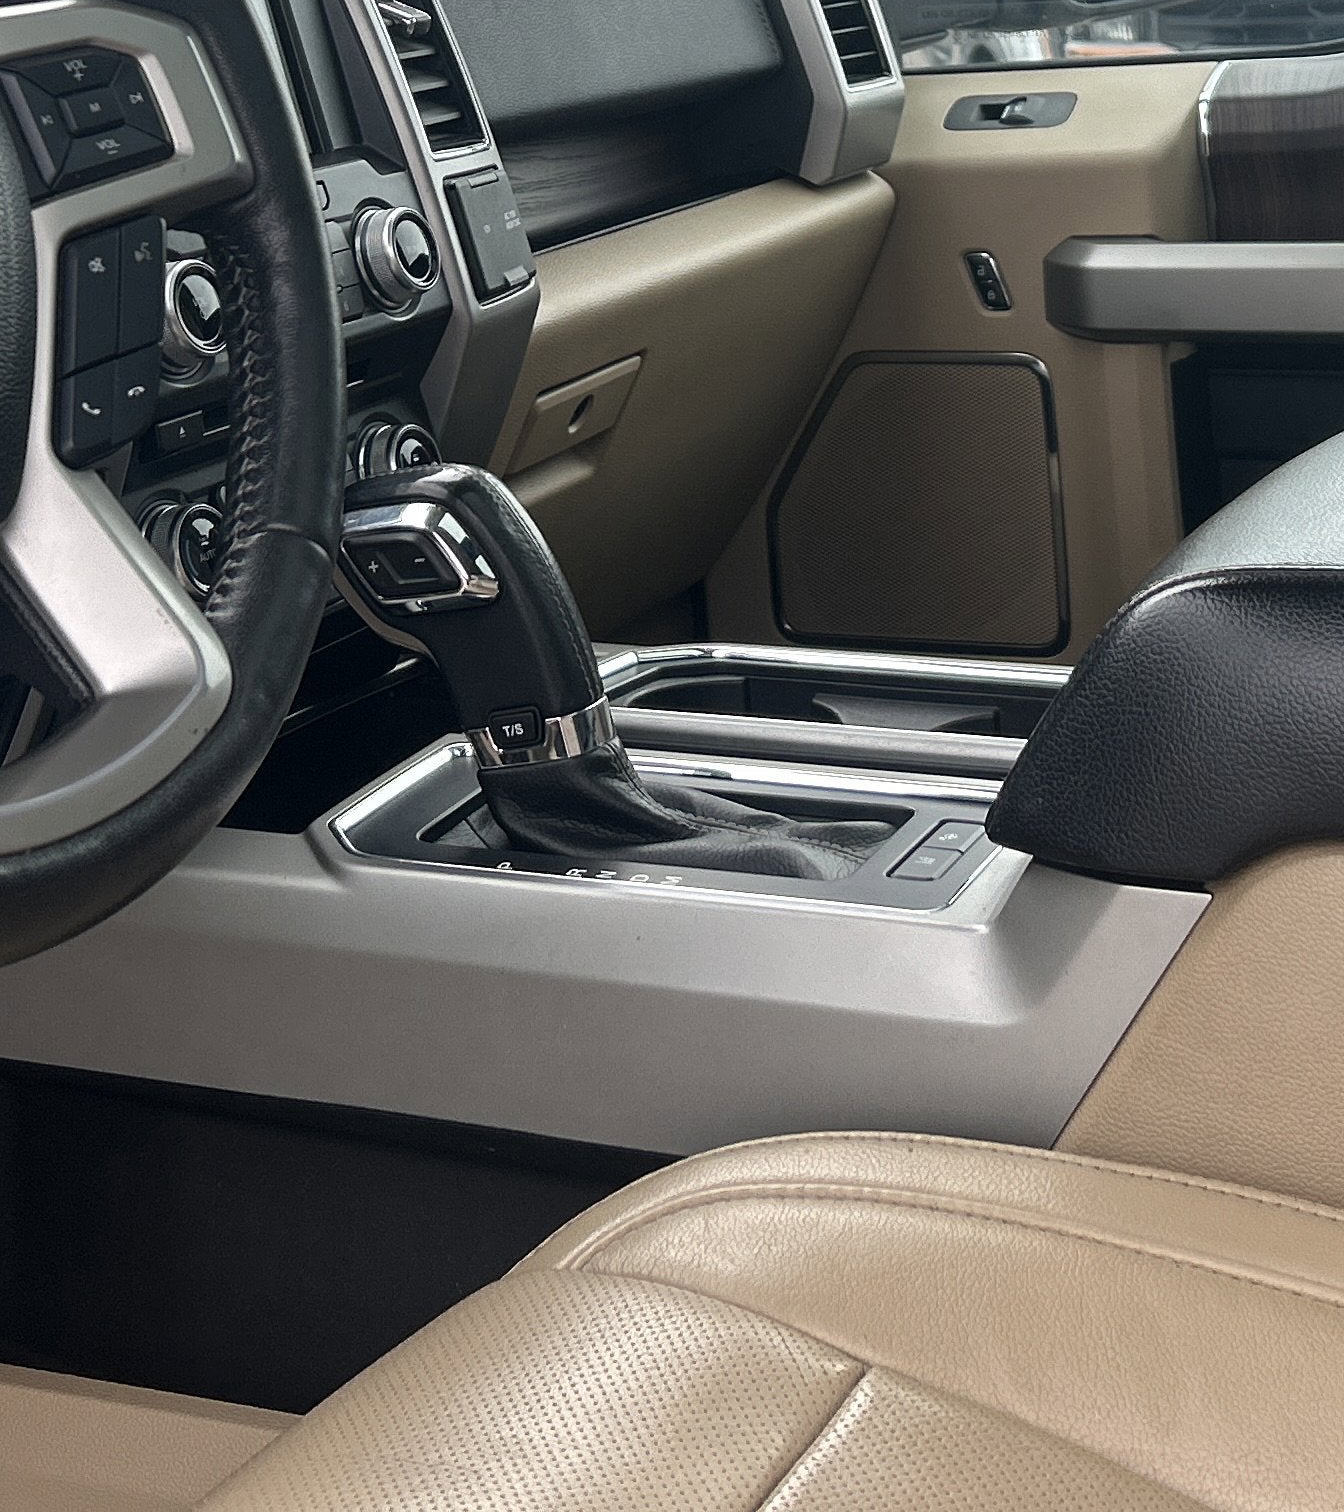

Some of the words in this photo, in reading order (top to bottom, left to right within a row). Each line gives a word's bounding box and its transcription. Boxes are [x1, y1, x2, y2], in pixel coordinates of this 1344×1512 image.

[63, 58, 88, 72] VOL
[95, 138, 121, 151] VOL
[501, 722, 524, 737] T/S
